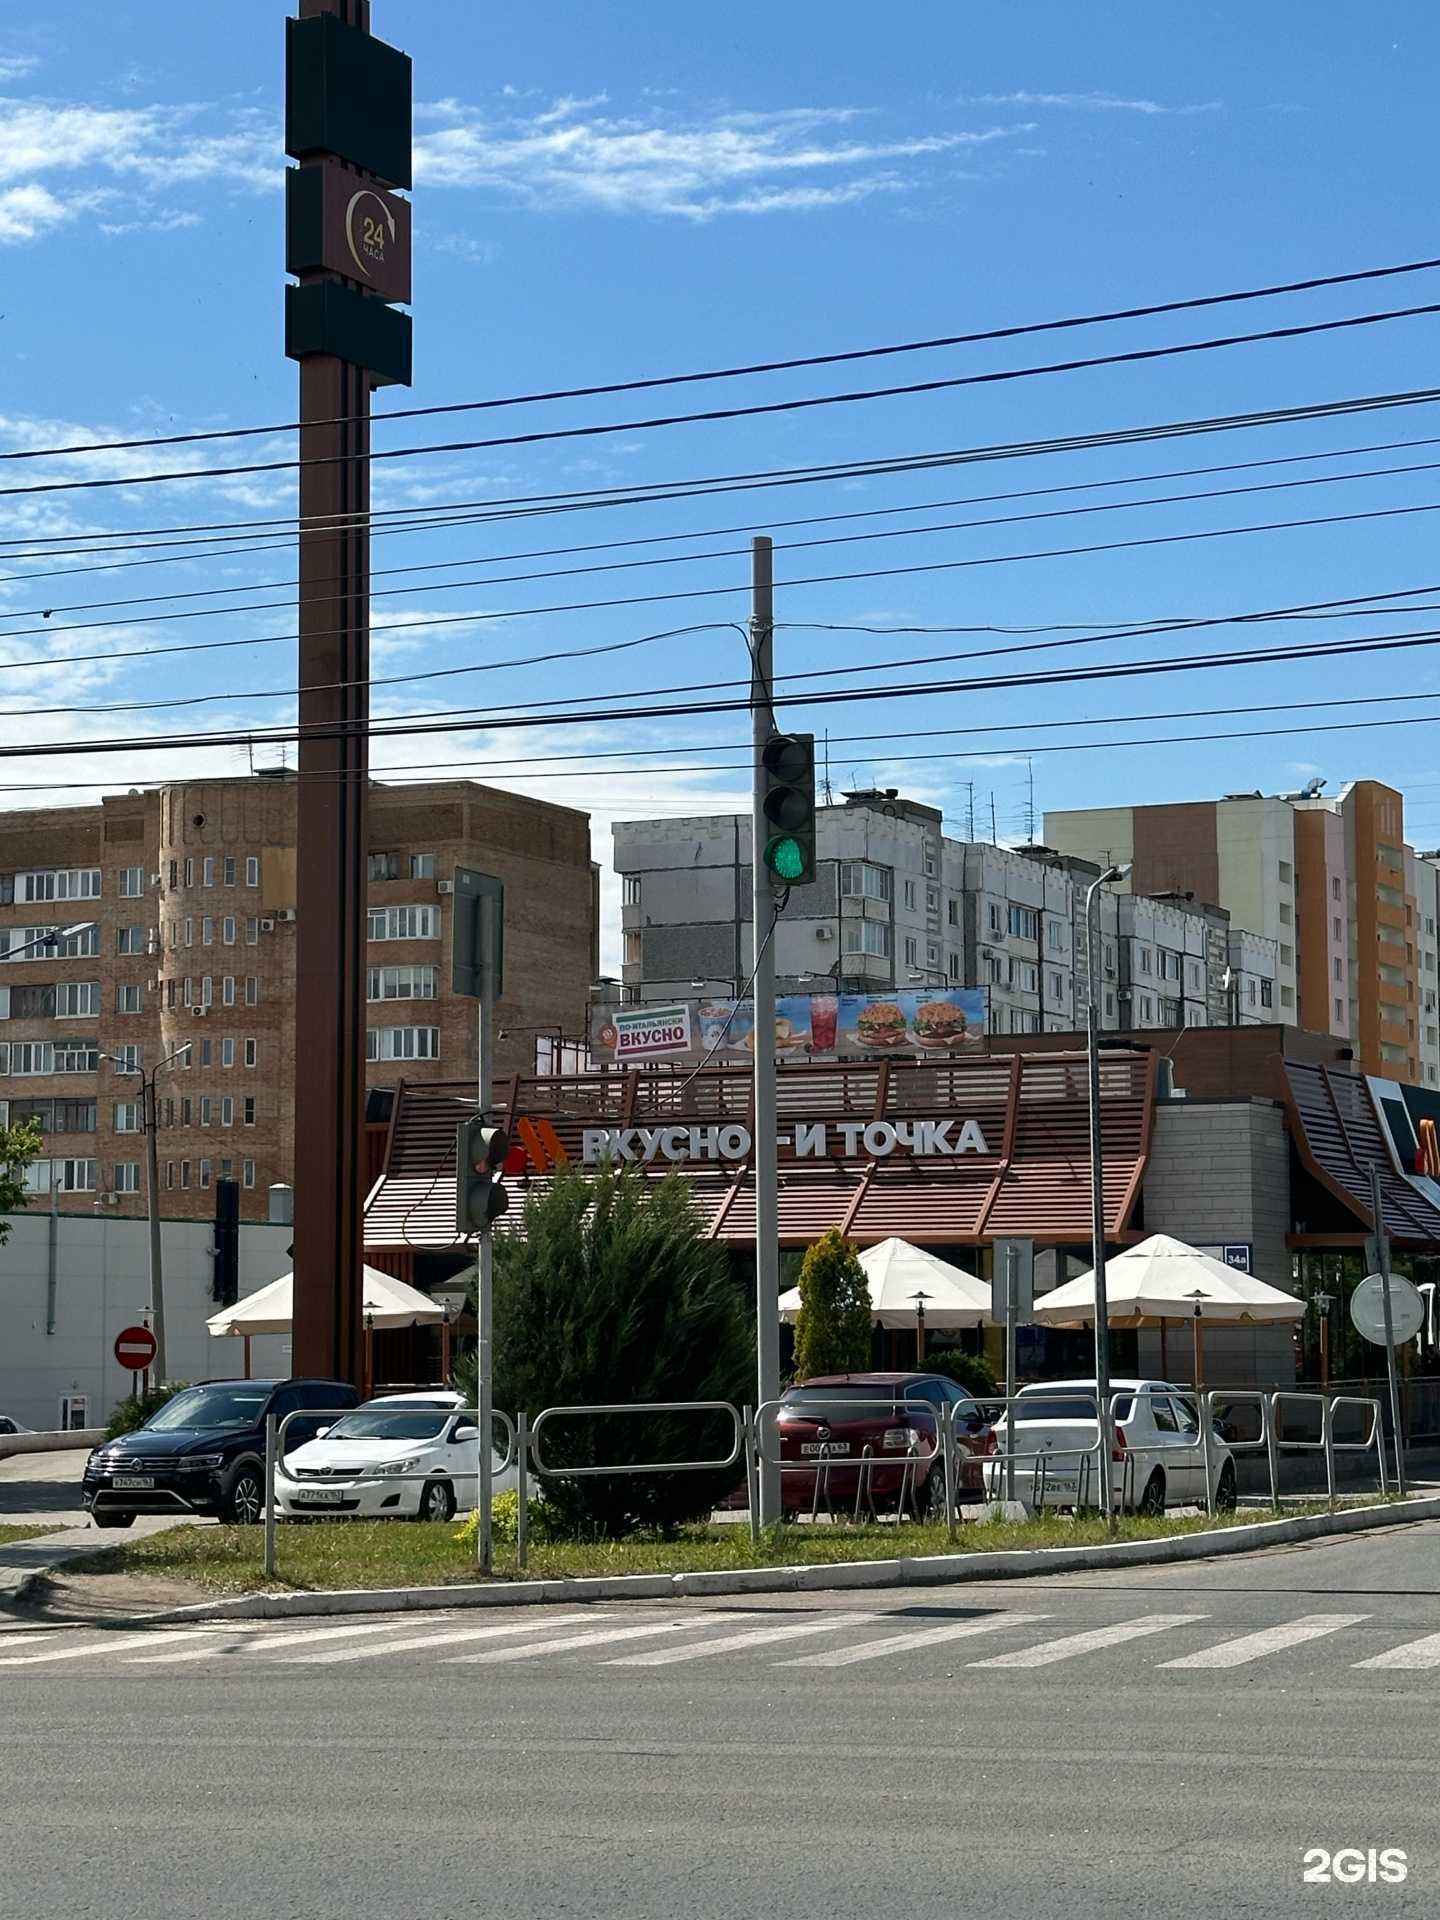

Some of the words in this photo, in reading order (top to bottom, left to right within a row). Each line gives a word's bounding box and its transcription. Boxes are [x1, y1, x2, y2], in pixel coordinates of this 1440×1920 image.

[364, 217, 385, 248] 24
[620, 1017, 683, 1032] ПО-ИТАЛЬЯНСКИ
[620, 1026, 684, 1047] ВКУСНО
[582, 1124, 752, 1162] ВКУСНО
[836, 1120, 991, 1157] ТОЧКА
